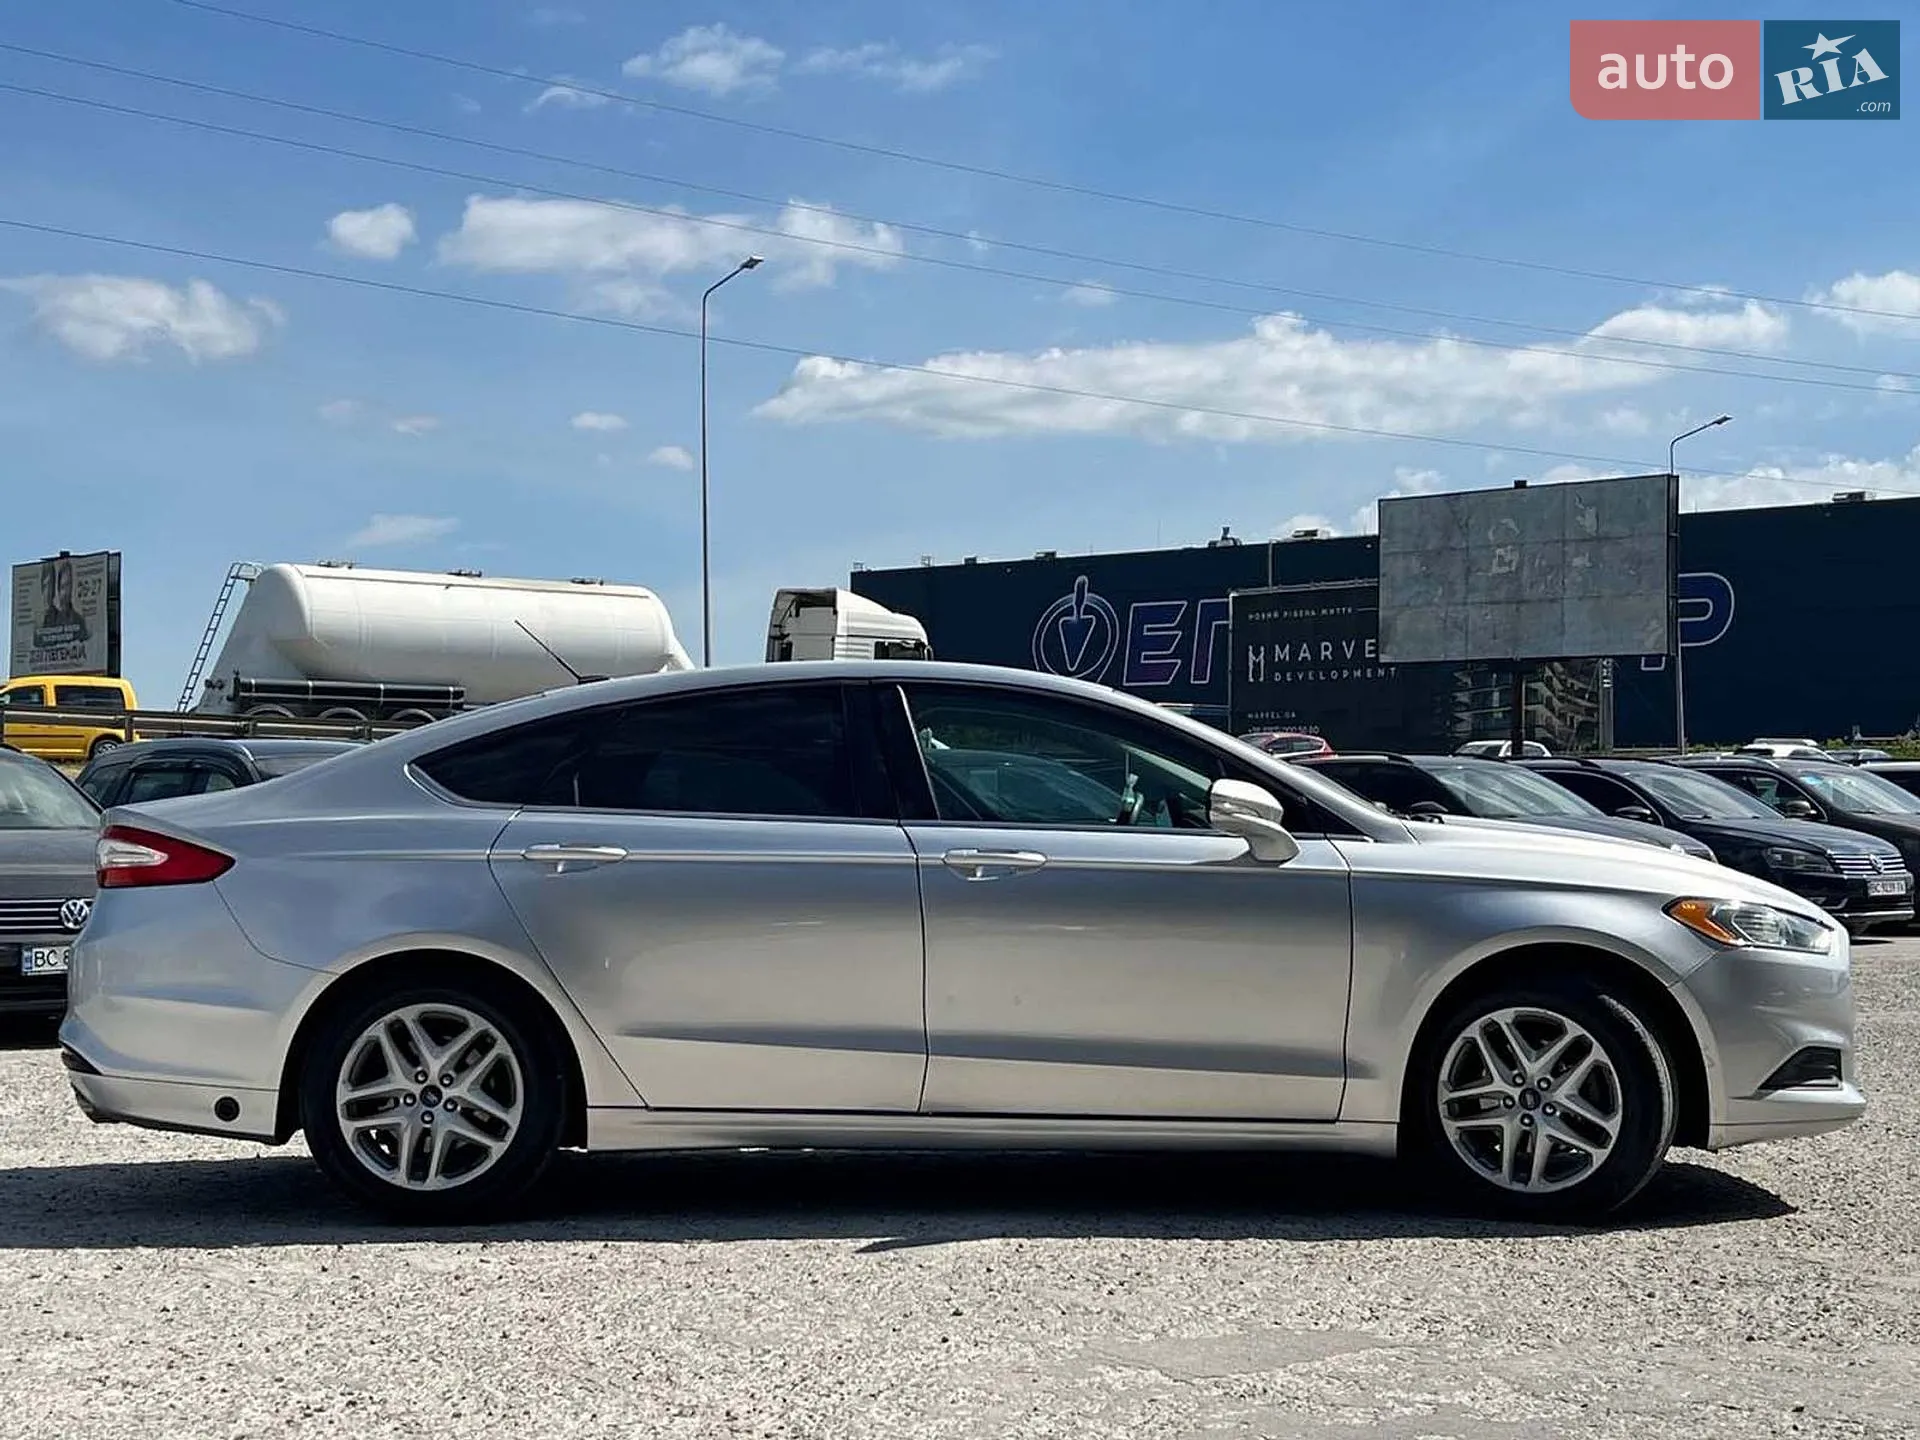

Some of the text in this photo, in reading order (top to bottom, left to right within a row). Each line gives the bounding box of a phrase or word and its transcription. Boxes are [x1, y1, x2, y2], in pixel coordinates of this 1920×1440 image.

[1274, 638, 1377, 662] MARVE
[1274, 667, 1397, 682] DEVELOPMENT
[35, 950, 58, 968] BC
